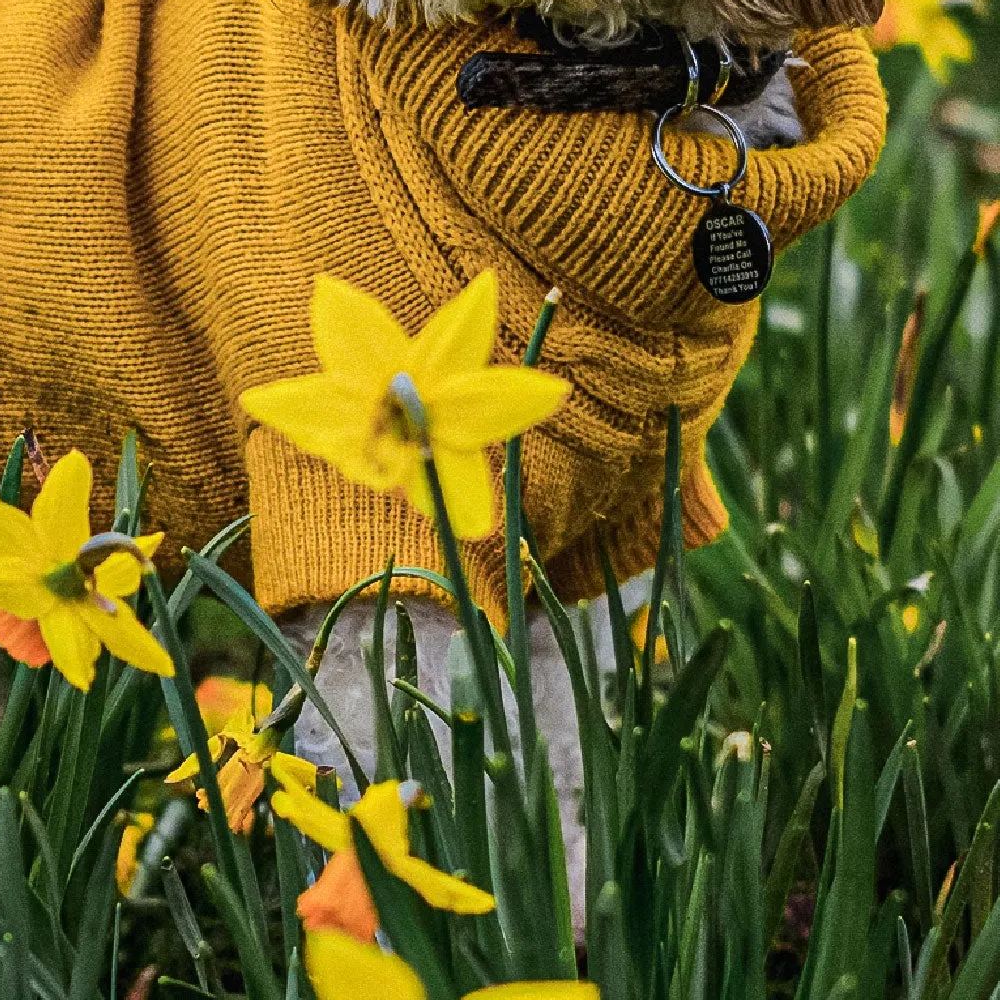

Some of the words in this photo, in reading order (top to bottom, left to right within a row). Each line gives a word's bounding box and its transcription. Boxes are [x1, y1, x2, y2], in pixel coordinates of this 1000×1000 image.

[706, 215, 744, 230] OSCAR
[710, 241, 734, 253] Found
[736, 240, 747, 248] Me
[709, 254, 735, 264] Please
[736, 249, 751, 259] Call
[714, 285, 738, 295] Thank
